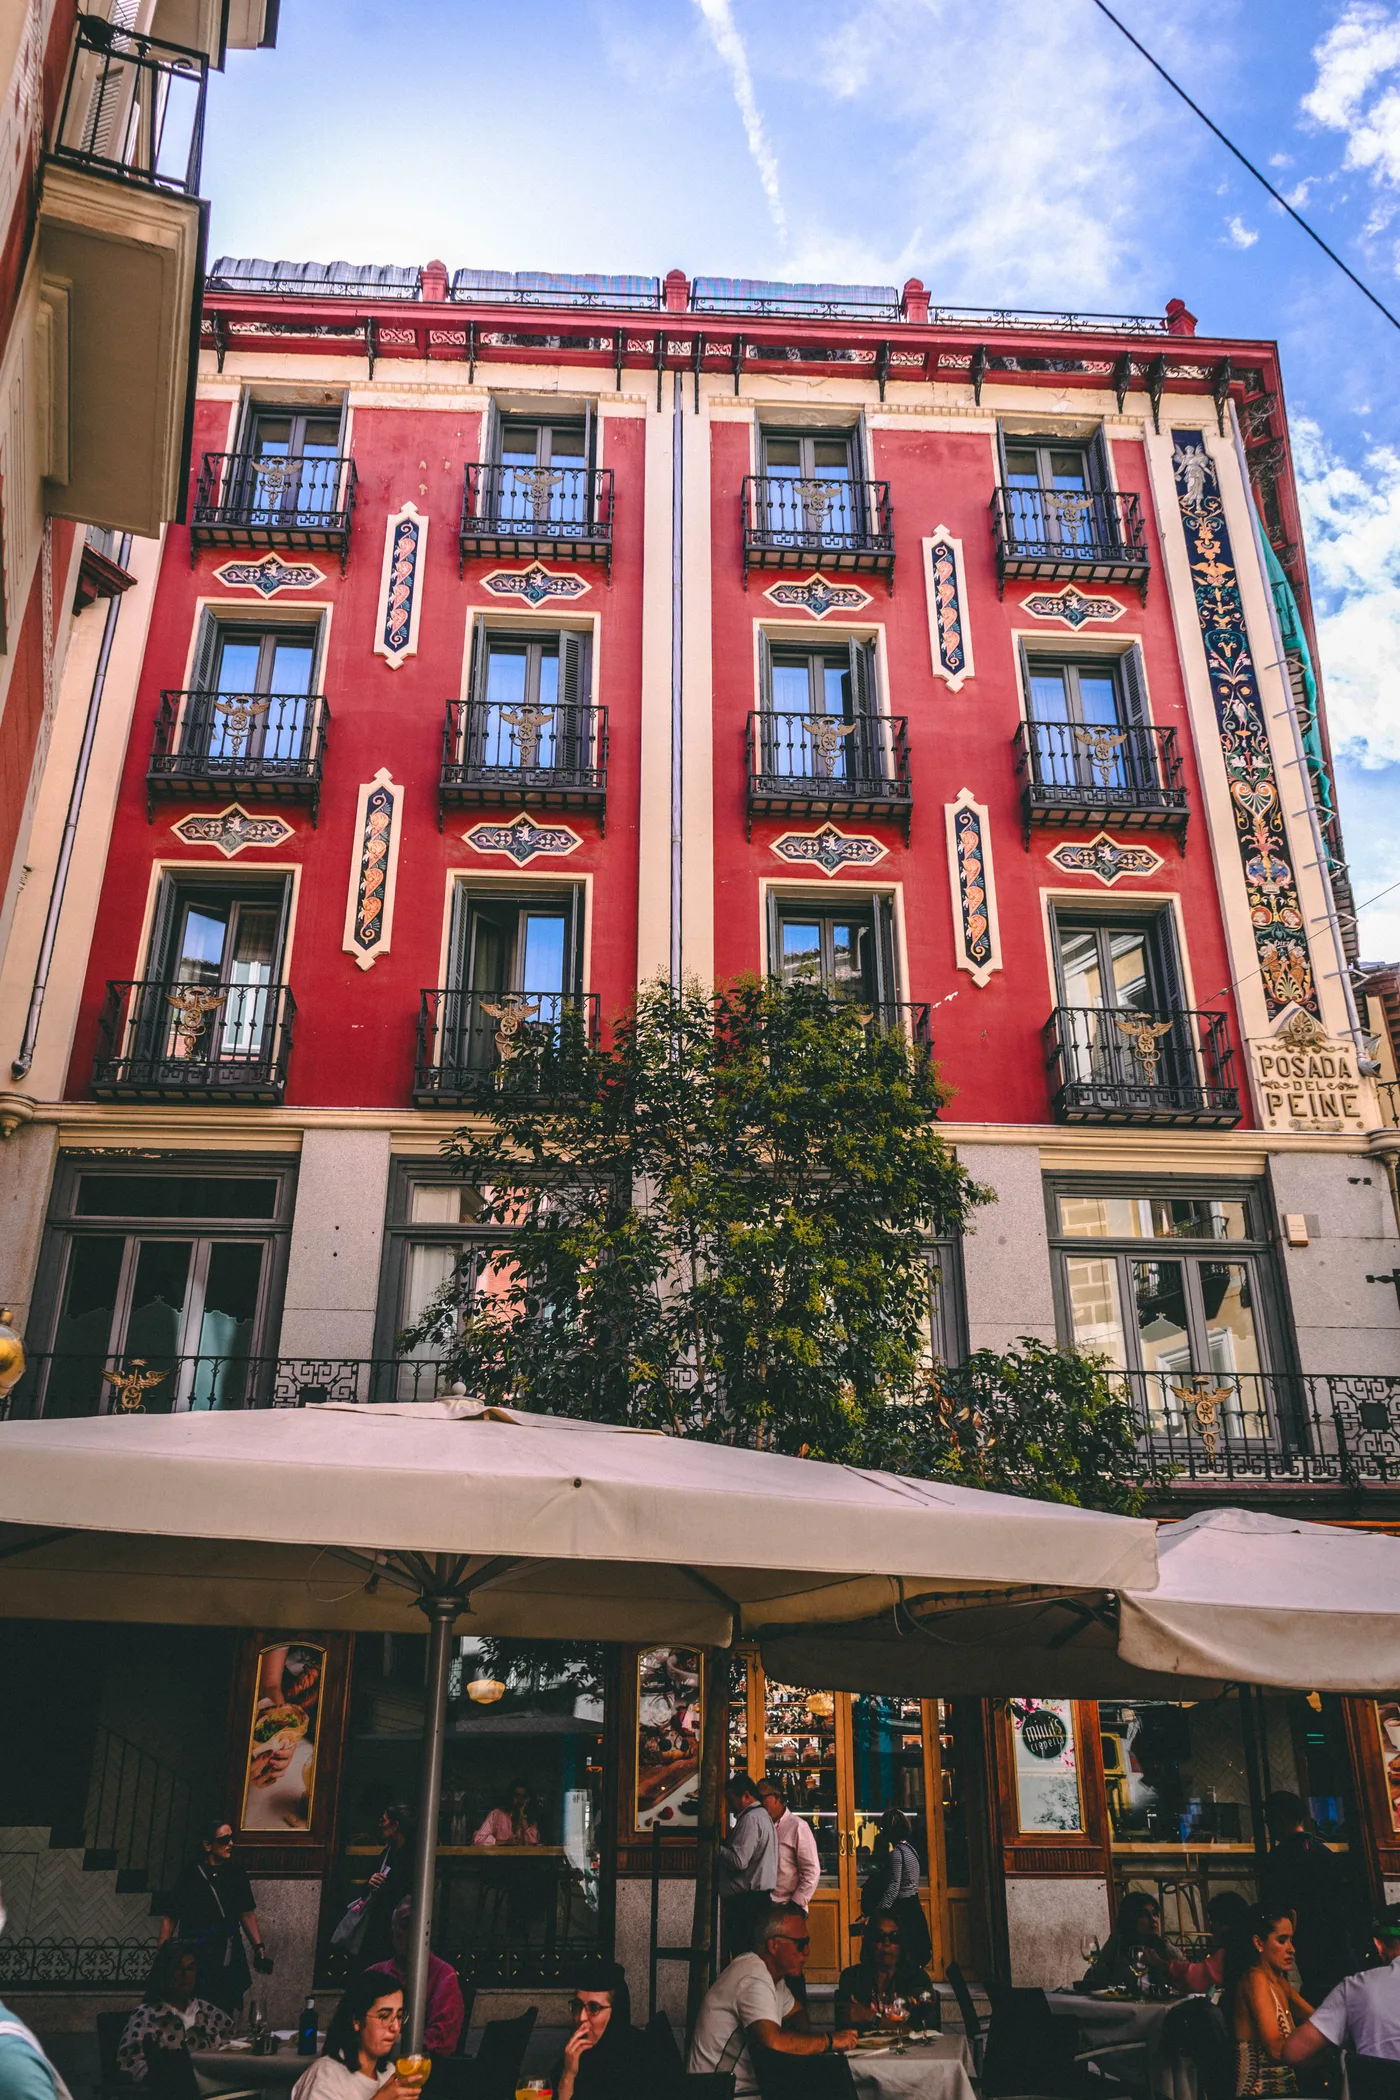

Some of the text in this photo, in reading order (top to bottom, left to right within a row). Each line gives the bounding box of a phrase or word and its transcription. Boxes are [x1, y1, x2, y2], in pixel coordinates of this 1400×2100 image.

[1260, 1055, 1352, 1078] POSADA
[1293, 1081, 1325, 1091] DEL
[1266, 1093, 1361, 1118] PEINE
